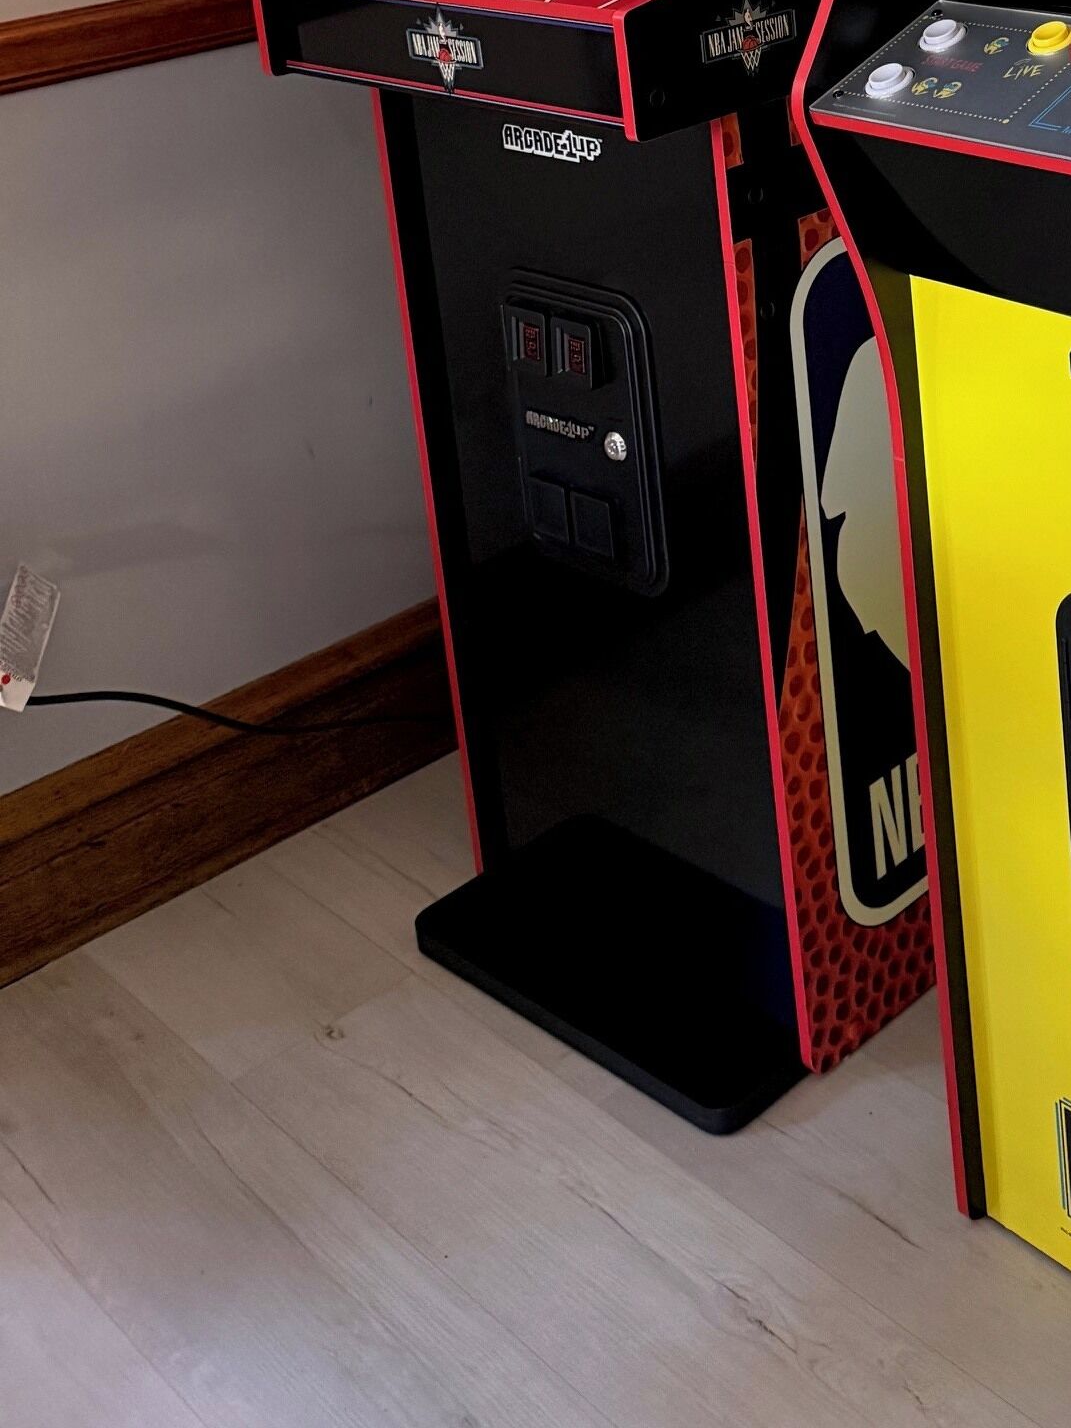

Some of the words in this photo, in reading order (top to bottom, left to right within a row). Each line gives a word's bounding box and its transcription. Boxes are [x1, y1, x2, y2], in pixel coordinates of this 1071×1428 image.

[447, 38, 477, 64] SESSION
[708, 31, 727, 58] NBA
[755, 14, 790, 44] SESSION
